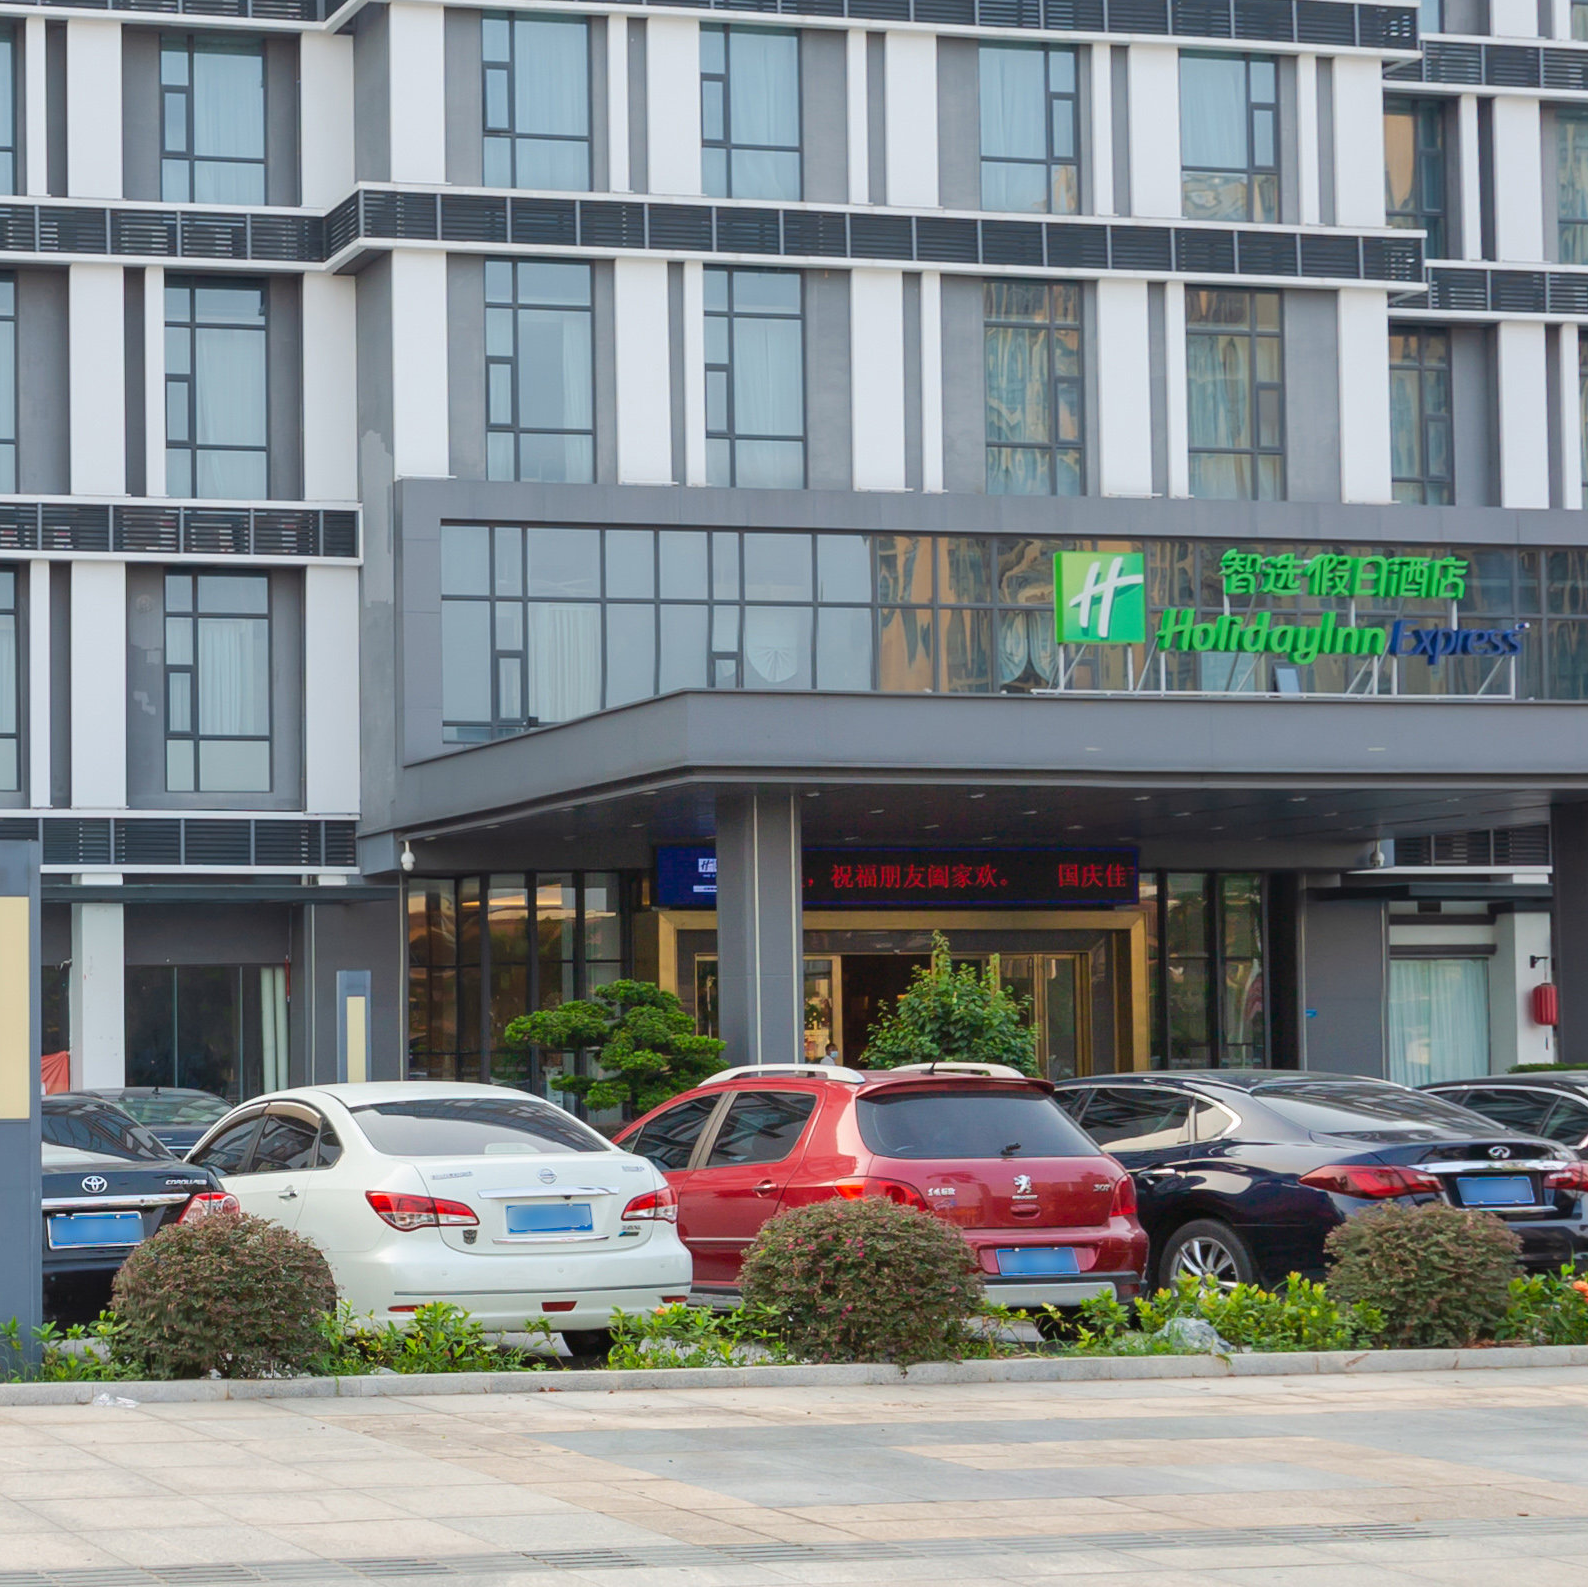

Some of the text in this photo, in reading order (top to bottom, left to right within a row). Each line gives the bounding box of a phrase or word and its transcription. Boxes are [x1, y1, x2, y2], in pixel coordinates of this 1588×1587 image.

[1218, 548, 1470, 601] 智选假日酒店
[1388, 619, 1523, 665] Express
[802, 863, 1135, 889] ，祝福朋友阖家欢。 国庆佳
